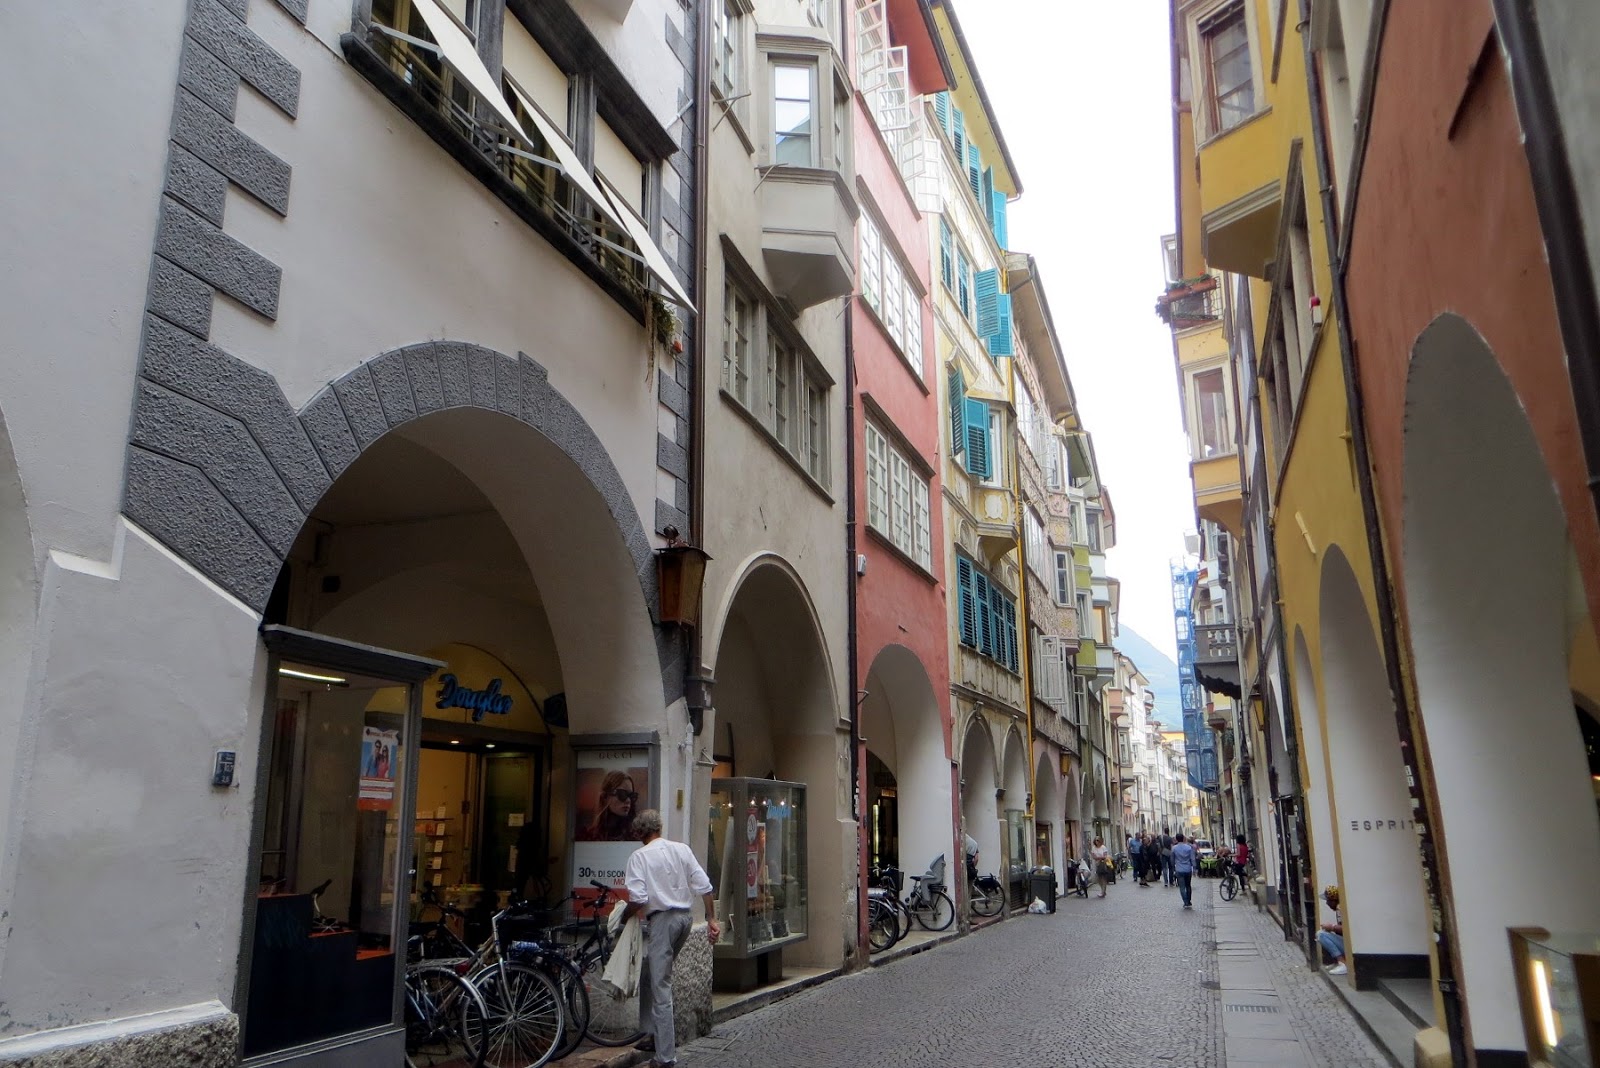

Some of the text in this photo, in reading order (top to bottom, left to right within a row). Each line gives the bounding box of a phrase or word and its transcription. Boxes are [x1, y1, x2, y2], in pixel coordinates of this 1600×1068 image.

[436, 674, 513, 722] Douglas
[1351, 820, 1415, 831] ESPRIT
[598, 870, 606, 878] DI
